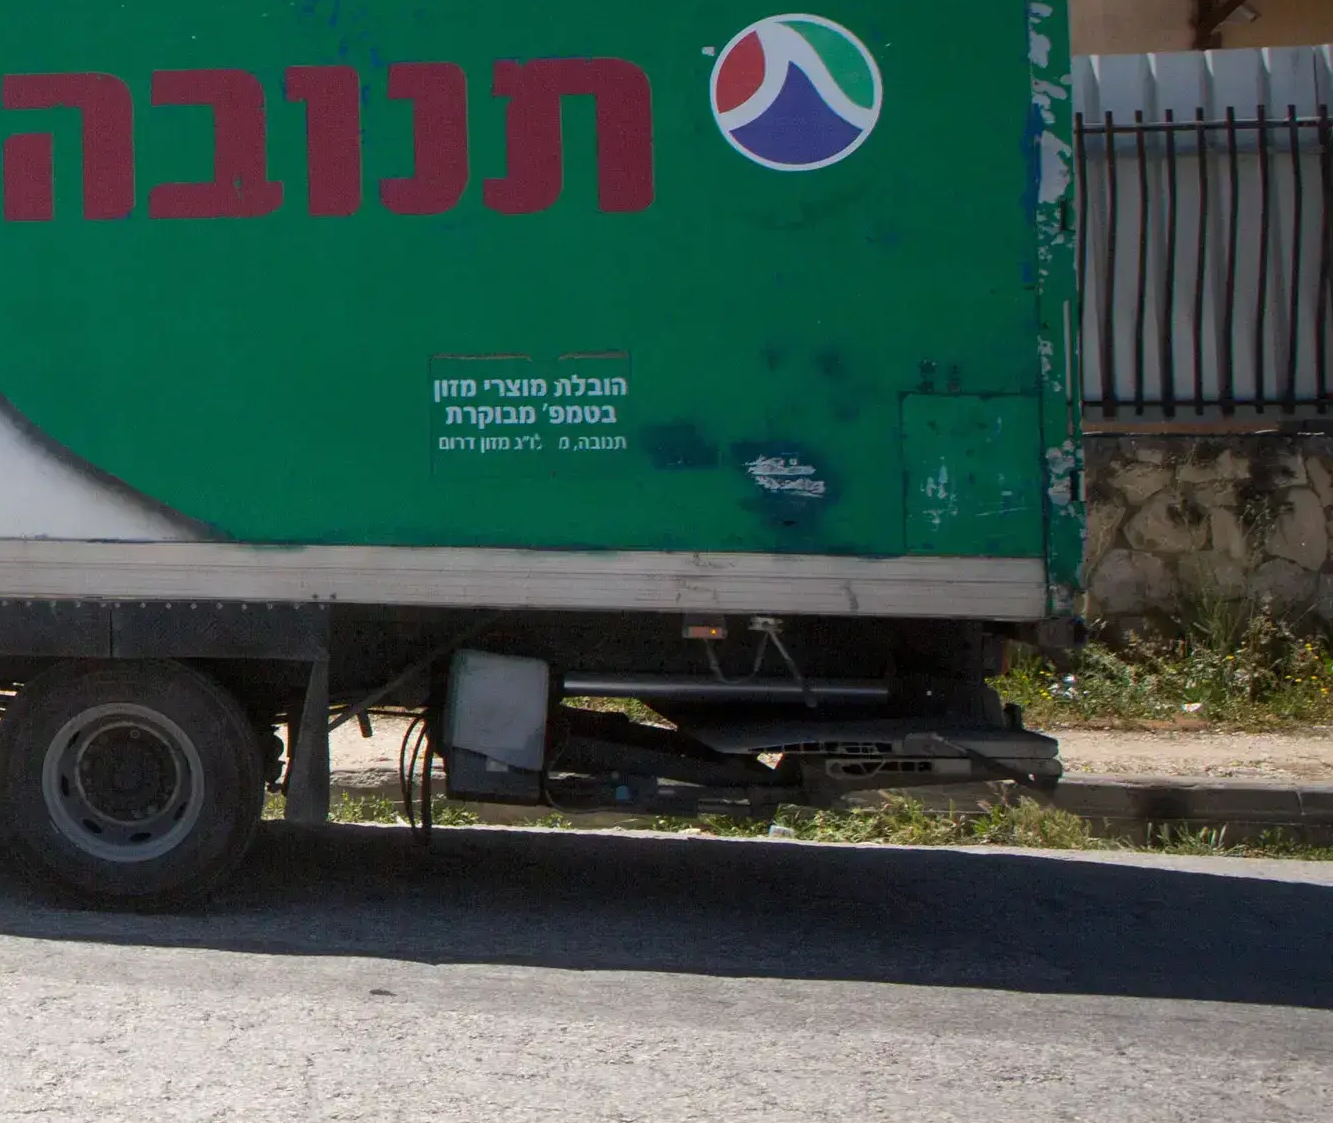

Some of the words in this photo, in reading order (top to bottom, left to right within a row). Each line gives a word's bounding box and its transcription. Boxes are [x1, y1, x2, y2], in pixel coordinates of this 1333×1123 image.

[2, 57, 653, 221] תנובה
[434, 379, 477, 402] מזון
[484, 378, 547, 397] מוצרי
[554, 374, 628, 397] הובלת
[446, 405, 536, 429] מבוקרת
[439, 436, 475, 450] דרום
[480, 437, 510, 453] מזון
